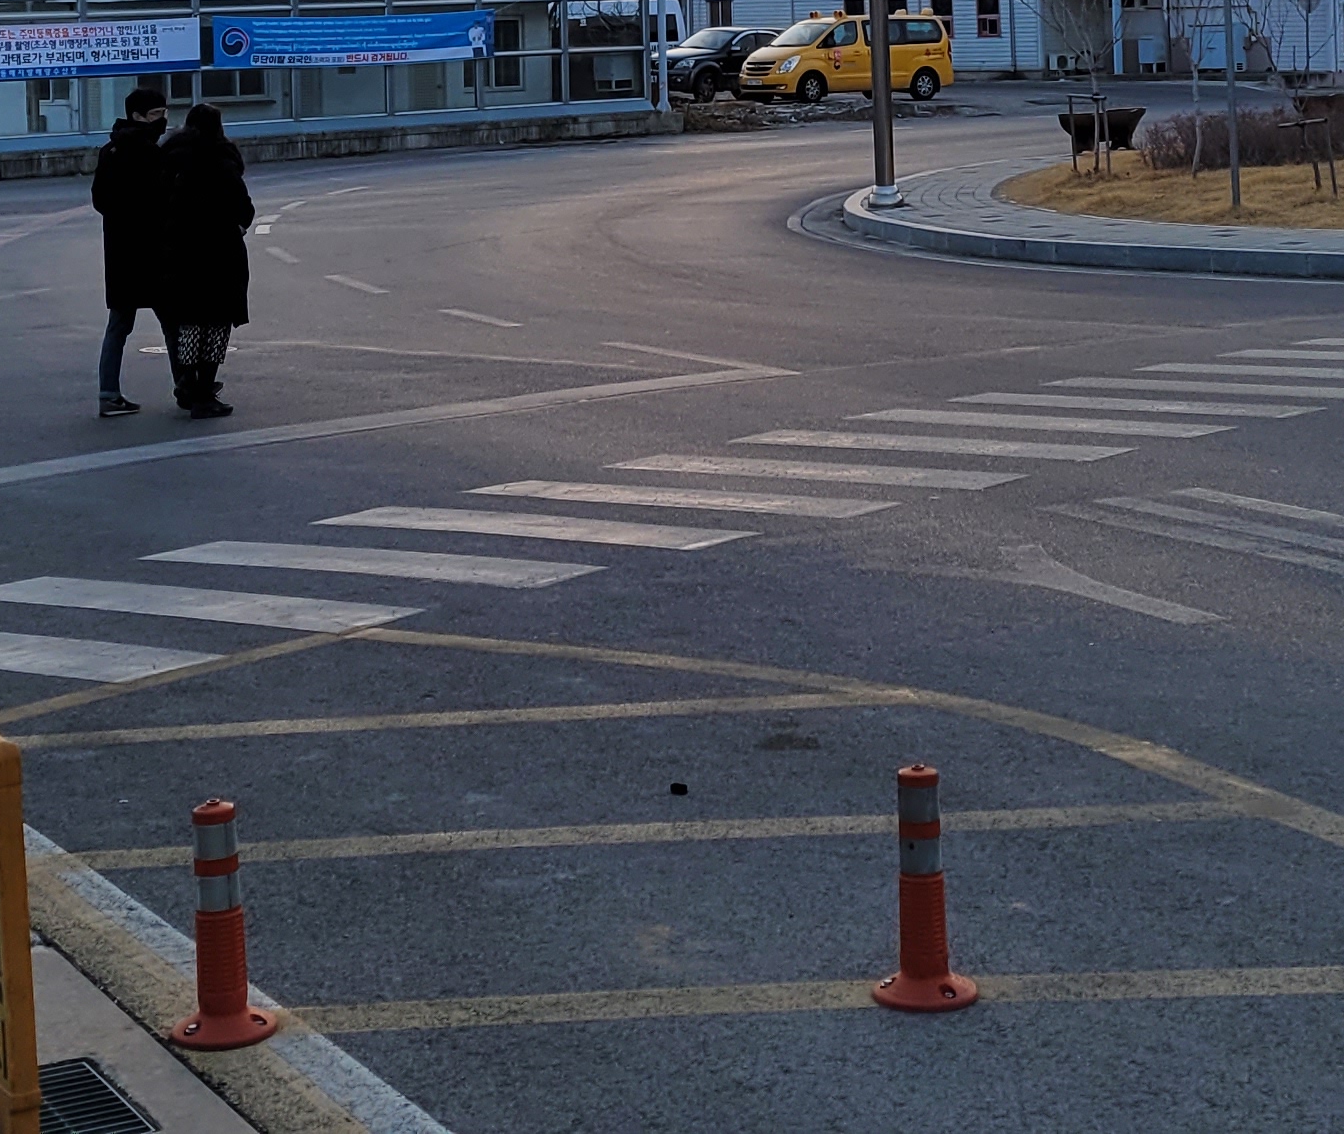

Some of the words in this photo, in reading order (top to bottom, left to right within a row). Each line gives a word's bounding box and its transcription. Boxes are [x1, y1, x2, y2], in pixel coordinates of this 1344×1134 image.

[0, 29, 16, 40] 또는
[19, 27, 70, 39] 주민등록증을
[72, 26, 114, 37] 도용하거나
[94, 37, 119, 48] 휴대폰
[132, 36, 140, 46] 할
[142, 35, 159, 46] 경우
[1, 52, 43, 66] 과태료가
[45, 50, 89, 64] 부과되며,
[90, 48, 160, 63] 형사고발됩니다
[252, 55, 286, 64] 무단이탈
[346, 53, 369, 63] 반드시
